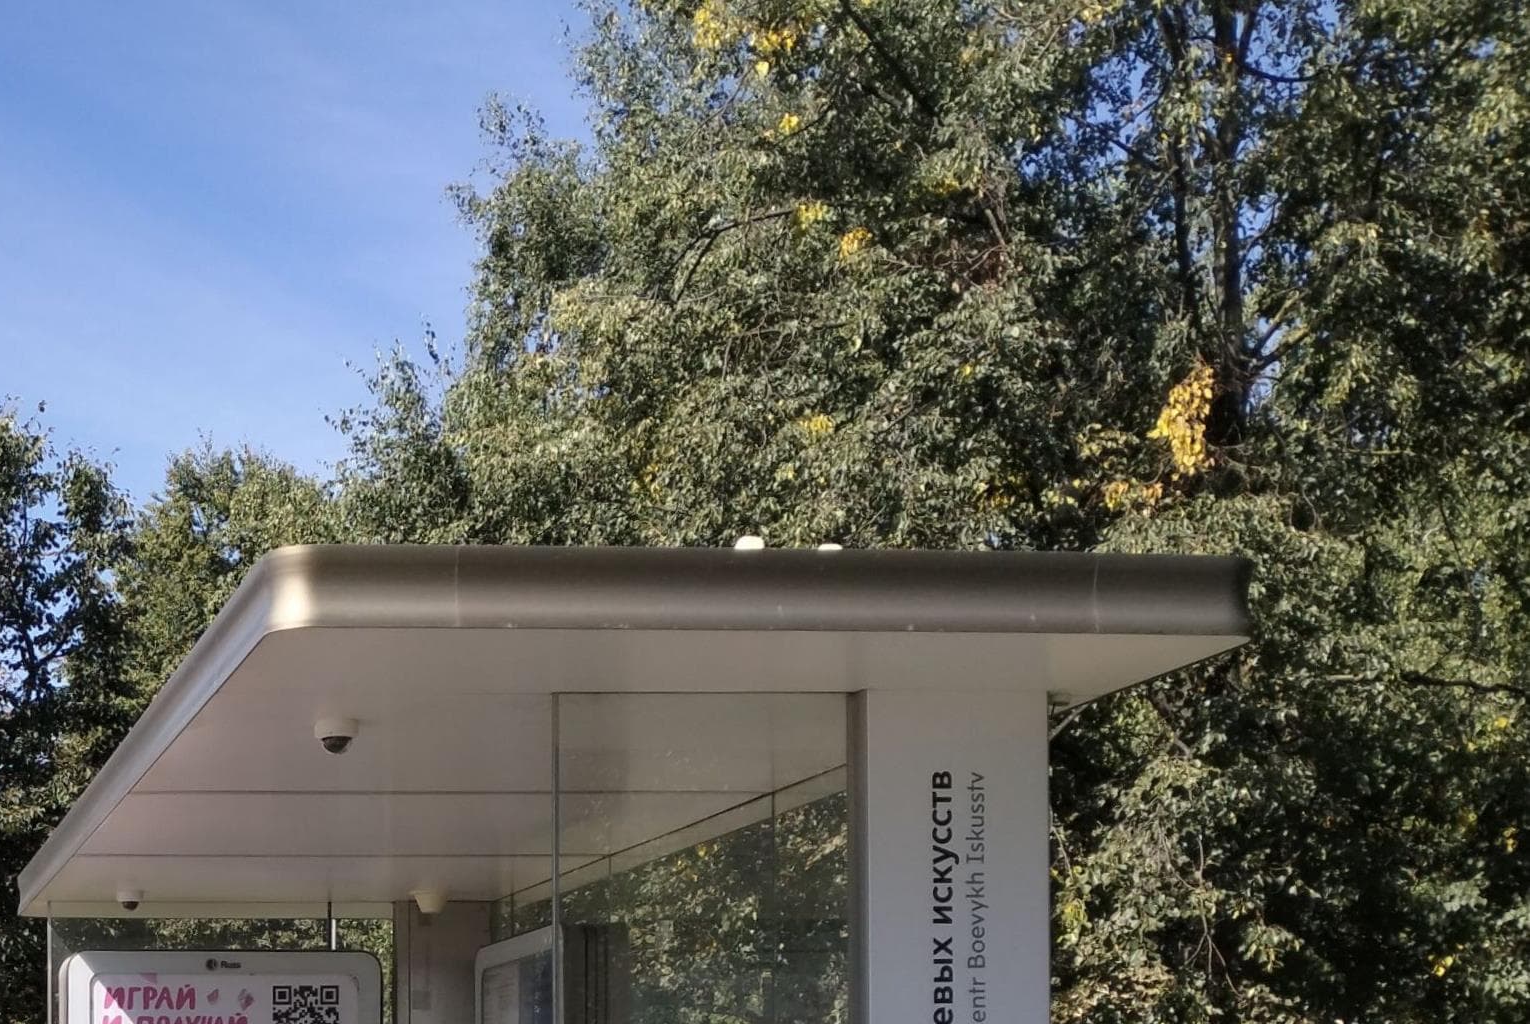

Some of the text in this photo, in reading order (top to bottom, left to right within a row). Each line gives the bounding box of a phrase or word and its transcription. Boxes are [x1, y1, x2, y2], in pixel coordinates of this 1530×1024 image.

[931, 770, 960, 924] искусств
[965, 771, 986, 864] Iskusstv
[965, 872, 989, 969] Boevykh
[104, 984, 196, 1010] ИГРАЙ
